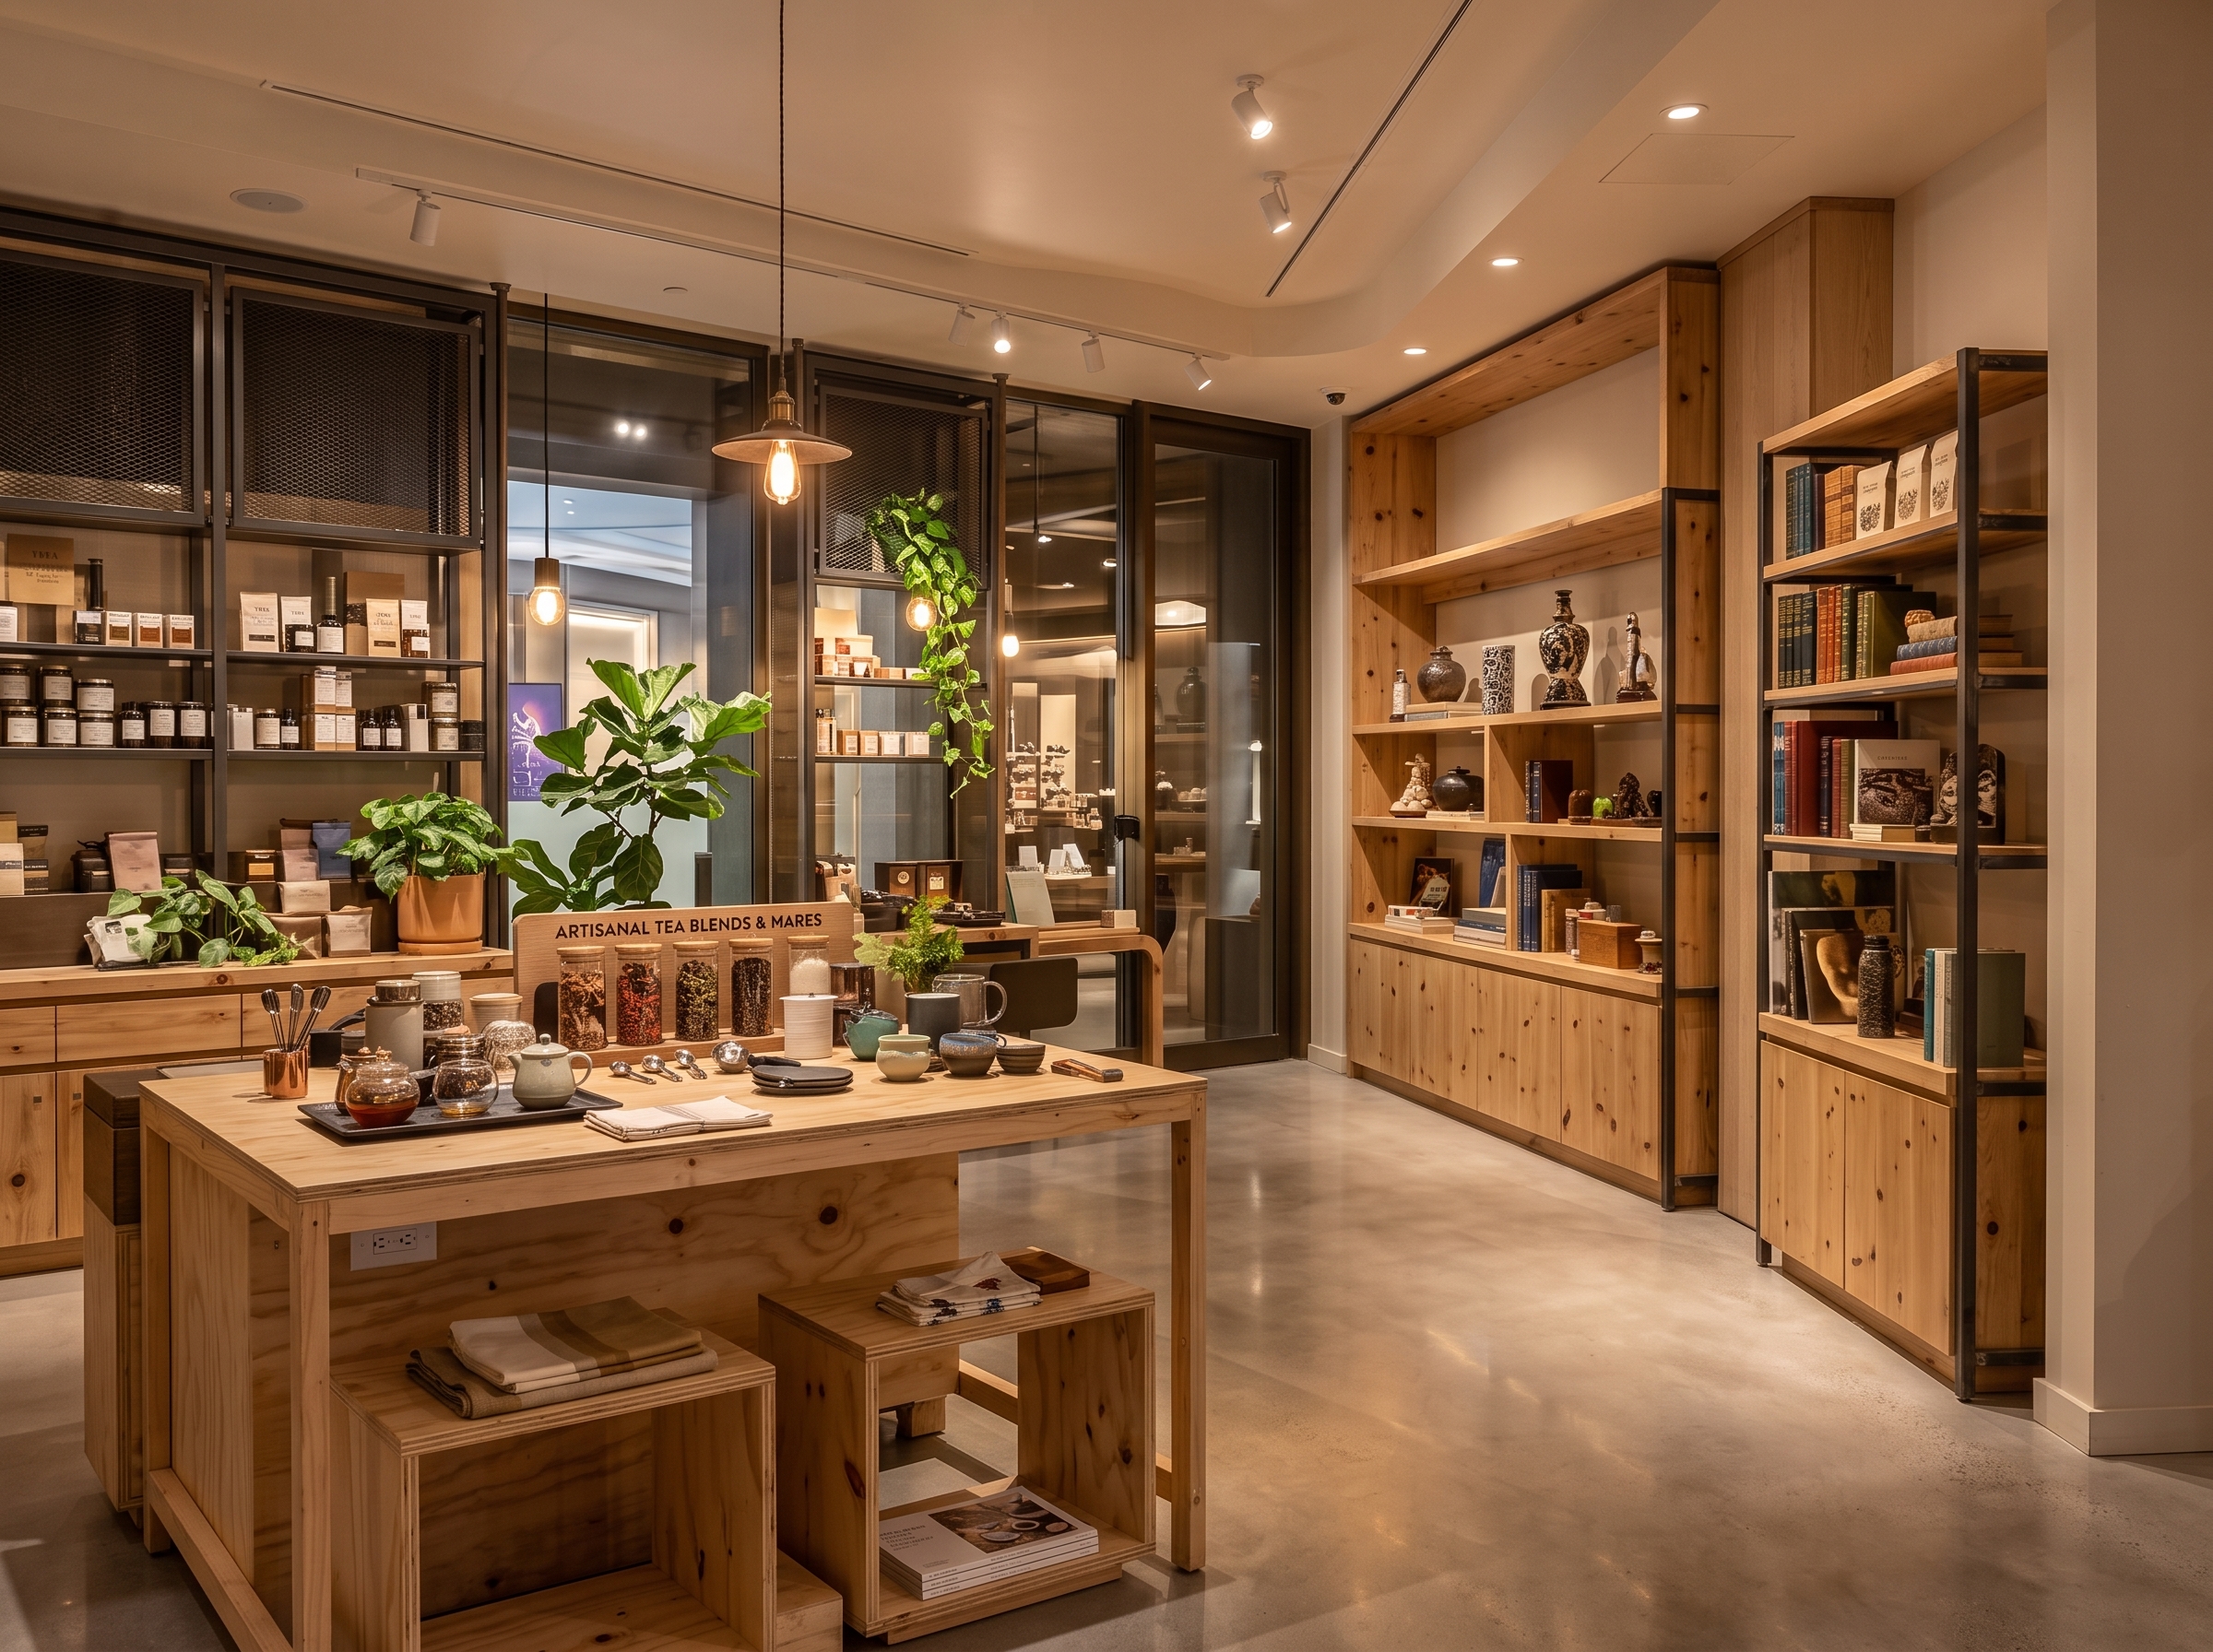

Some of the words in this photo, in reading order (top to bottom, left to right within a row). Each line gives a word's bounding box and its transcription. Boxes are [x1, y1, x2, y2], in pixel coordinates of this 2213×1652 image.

[555, 921, 650, 939] ARTISANAL
[654, 919, 686, 934] TEA
[690, 915, 751, 933] BLENDS
[755, 915, 766, 930] &
[771, 913, 822, 928] MARES
